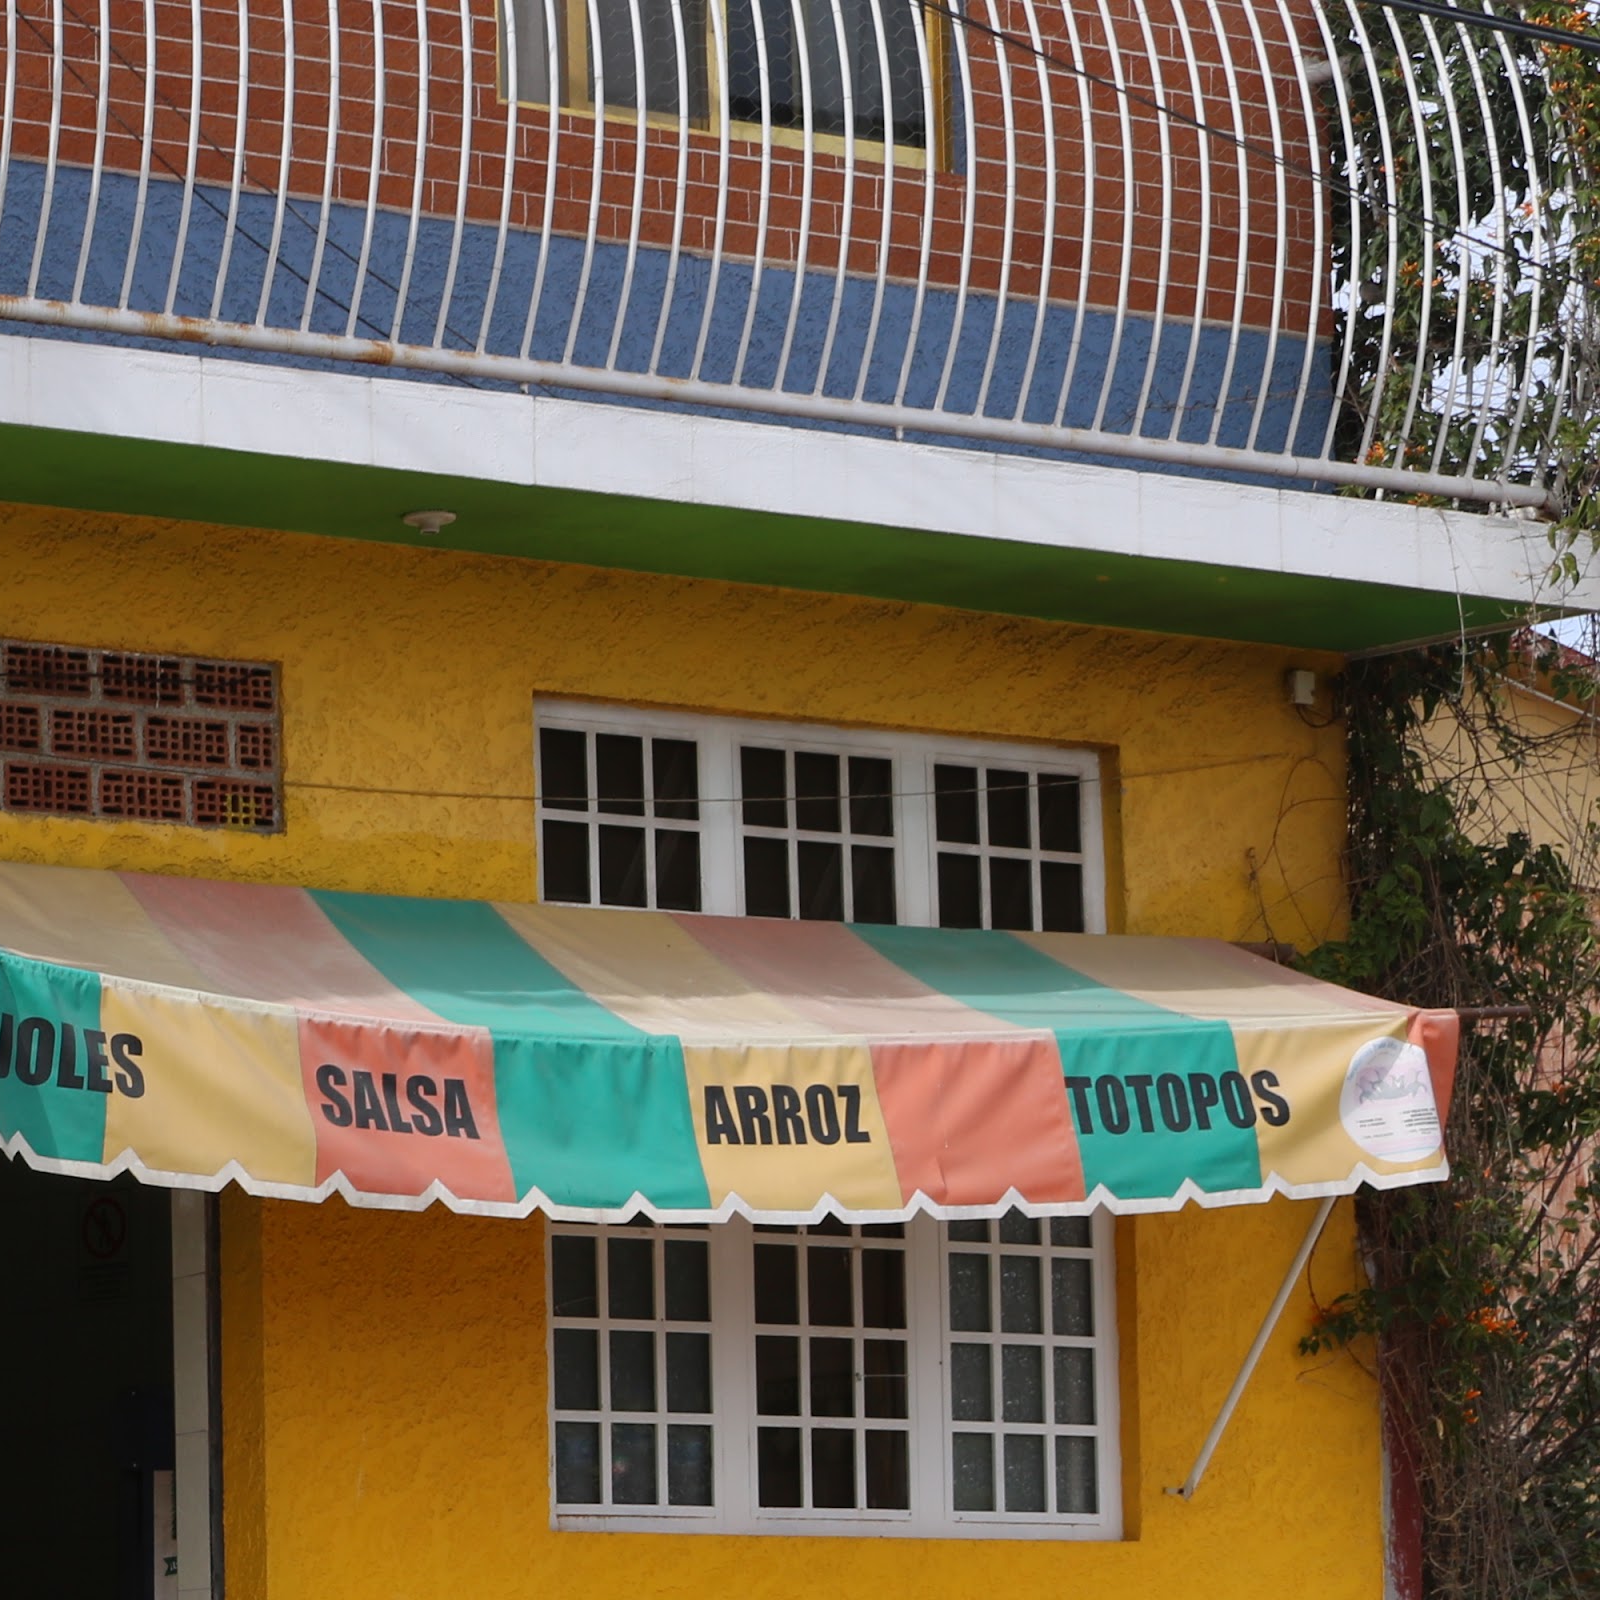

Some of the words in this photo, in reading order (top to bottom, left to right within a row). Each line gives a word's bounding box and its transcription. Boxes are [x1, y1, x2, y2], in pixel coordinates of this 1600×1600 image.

[316, 1064, 481, 1140] SALSA
[704, 1084, 871, 1145] ARROZ
[1064, 1069, 1291, 1135] TOTOPOS
